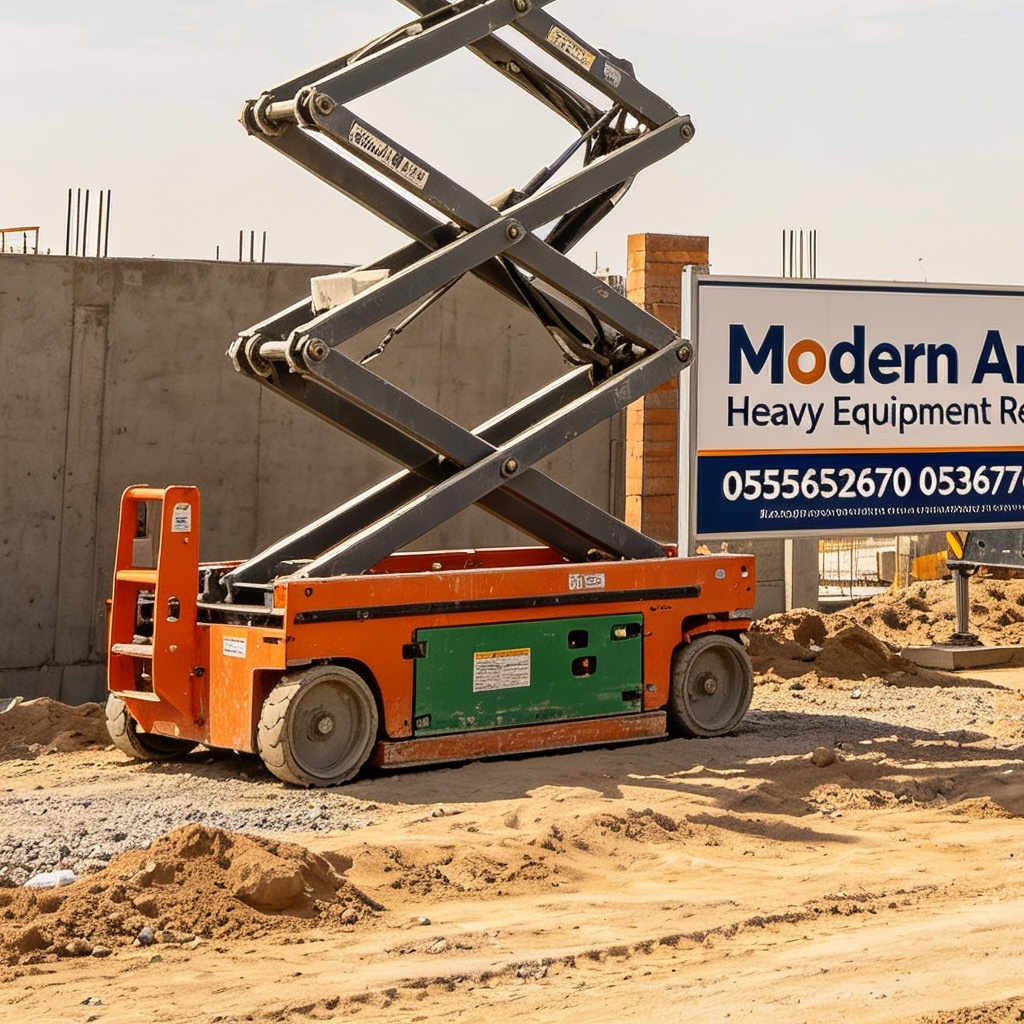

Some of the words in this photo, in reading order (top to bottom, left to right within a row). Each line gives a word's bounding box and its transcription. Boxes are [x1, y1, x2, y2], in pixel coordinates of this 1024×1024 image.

[728, 324, 959, 385] Modern
[727, 396, 824, 434] Heavy
[833, 395, 992, 435] Equipment
[722, 467, 911, 502] 0555652670
